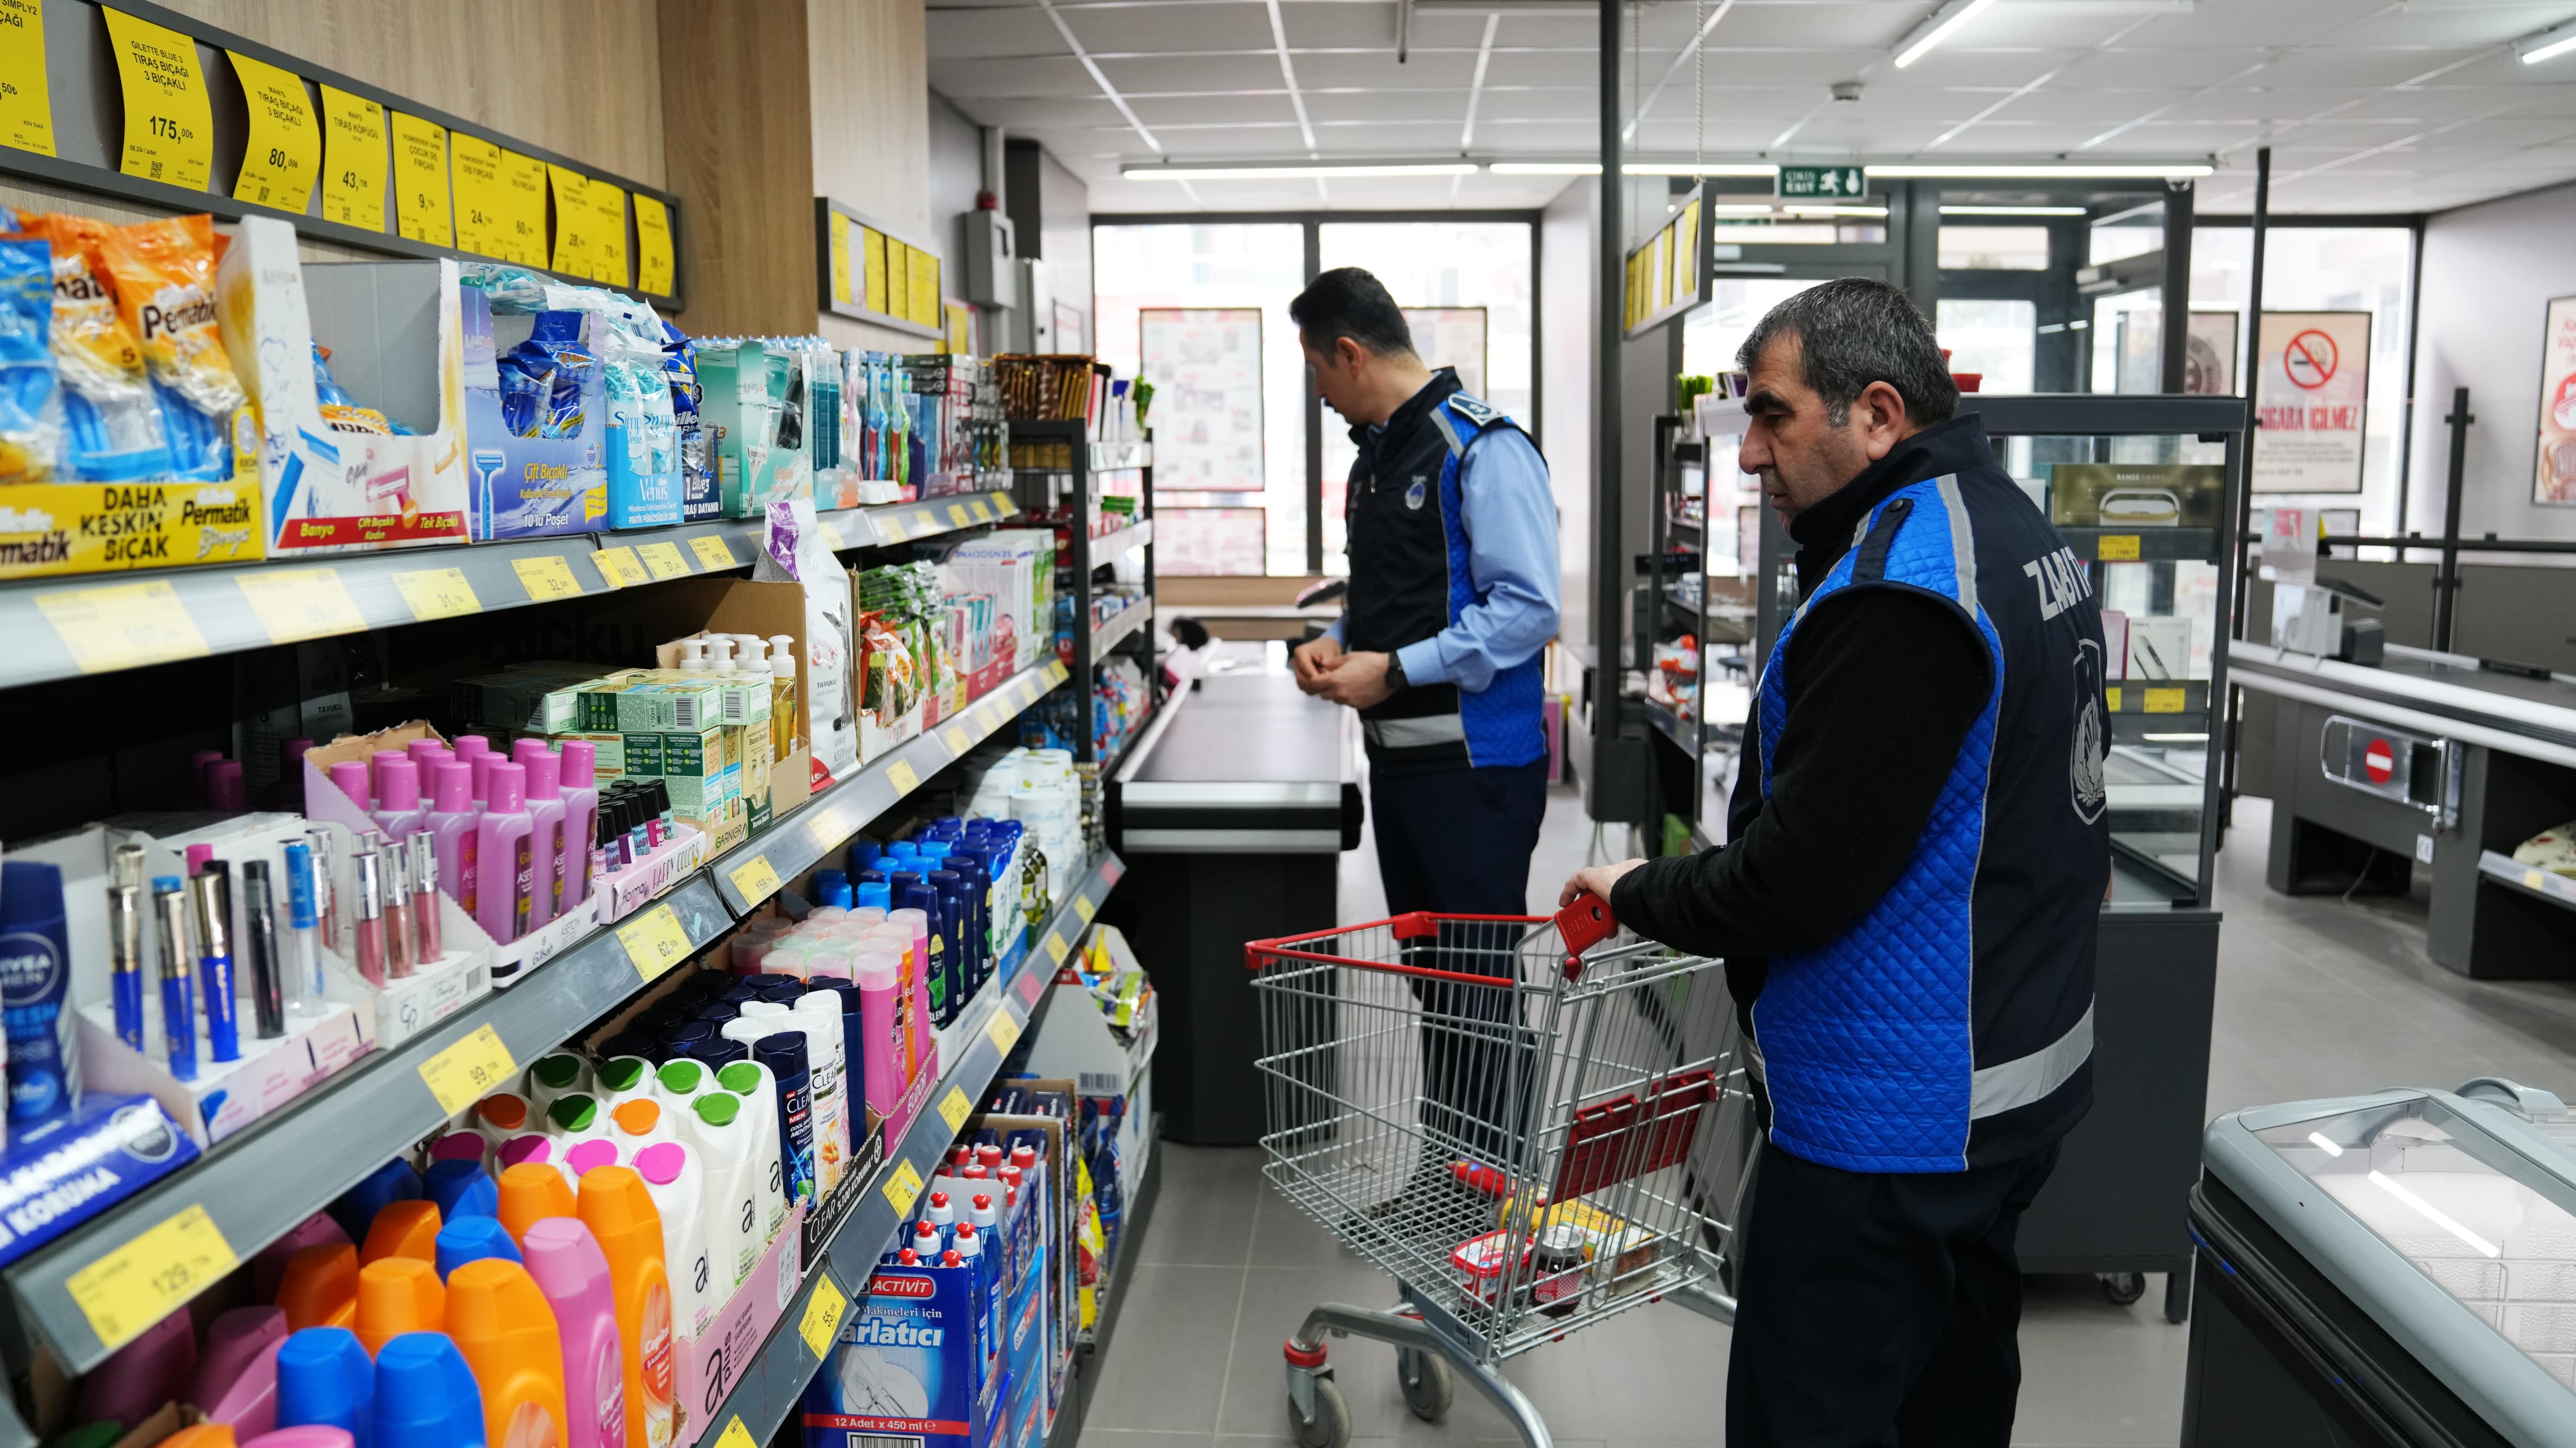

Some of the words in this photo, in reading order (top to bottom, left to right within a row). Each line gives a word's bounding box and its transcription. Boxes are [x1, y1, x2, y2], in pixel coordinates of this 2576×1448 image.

[132, 41, 159, 56] GILETTE
[160, 50, 177, 61] BLUE
[179, 55, 183, 63] 3
[132, 53, 159, 72] TIRAŞ
[160, 60, 189, 78] BIÇAĞI
[144, 70, 150, 81] 3
[151, 73, 186, 91] BIÇAKLI
[257, 91, 279, 108] TIRAŞ
[280, 99, 304, 115] BIÇAĞI
[267, 107, 272, 116] 3
[273, 109, 301, 127] BIÇAKLI
[334, 117, 352, 132] TIRAŞ
[1786, 182, 1814, 193] EXIT
[525, 463, 539, 483] Çift
[540, 462, 568, 484] Bıçaklı
[104, 488, 168, 510] DAHA
[698, 502, 719, 514] DAYANIR
[182, 499, 250, 526] Permatik
[545, 512, 569, 527] Poşet
[300, 522, 335, 538] Banyo
[420, 518, 434, 530] Tek
[2023, 546, 2093, 622] ZABIT
[817, 678, 836, 689] TAVUKLU
[705, 734, 720, 747] GARNIER
[749, 736, 759, 746] Burun
[716, 824, 742, 849] GARNIER
[622, 881, 647, 904] flormar
[677, 842, 700, 872] COLORS
[812, 1067, 836, 1090] CLEAR
[789, 1111, 806, 1124] MEN
[810, 1198, 836, 1244] CLEAR
[838, 1188, 851, 1213] %100
[872, 1279, 929, 1293] ACTİVİT
[861, 1304, 919, 1318] Makineleri
[922, 1308, 943, 1318] için
[835, 1418, 847, 1427] 12
[849, 1419, 874, 1428] Adet
[887, 1420, 906, 1430] 450
[909, 1421, 922, 1431] ml
